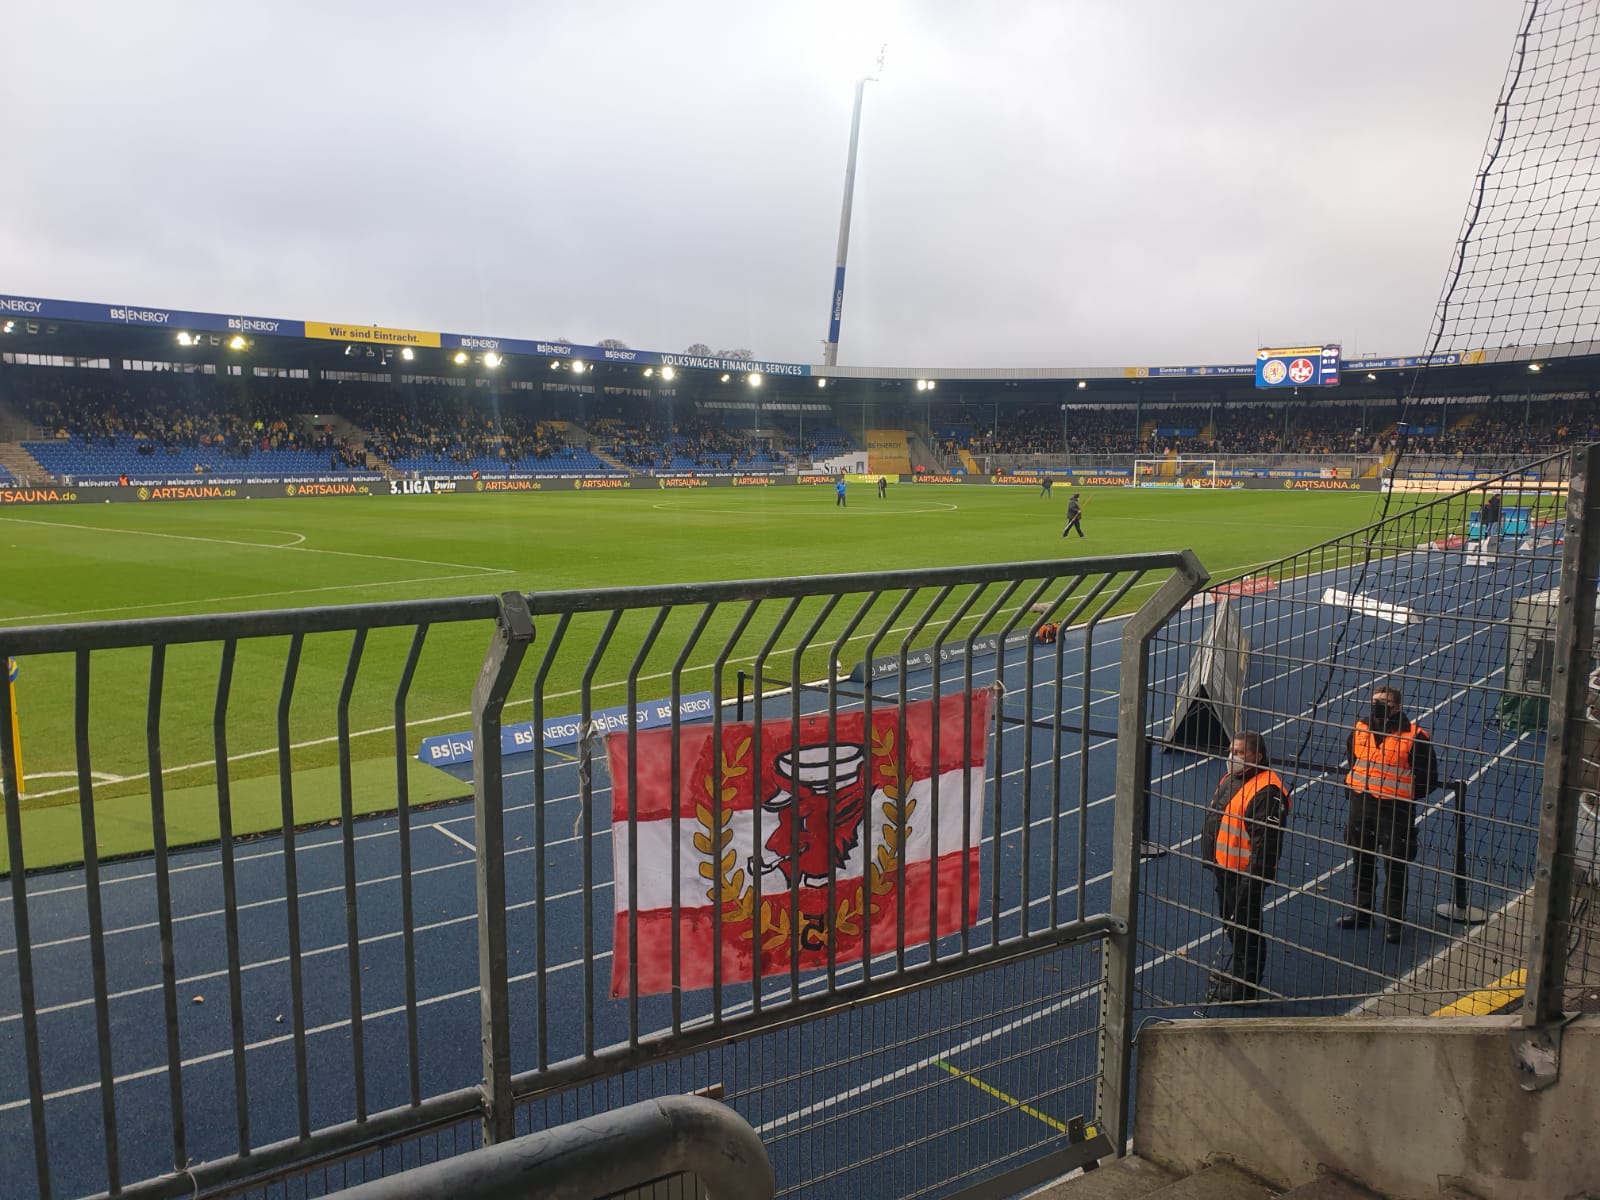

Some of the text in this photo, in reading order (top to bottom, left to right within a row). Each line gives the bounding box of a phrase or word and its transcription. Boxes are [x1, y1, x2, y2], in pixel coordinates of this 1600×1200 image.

[329, 327, 420, 344] Wir sind Eintracht.
[661, 354, 802, 376] VOLKSWAGEN FINANCIAL SERVICES
[298, 484, 369, 495] ARTSAUNA.de
[390, 480, 456, 494] 3. LIGA bwin
[485, 480, 541, 490] ARTSAUNA.de
[1294, 479, 1360, 489] ARTSAUNA.de
[152, 487, 237, 499] ARTSAUNA.de
